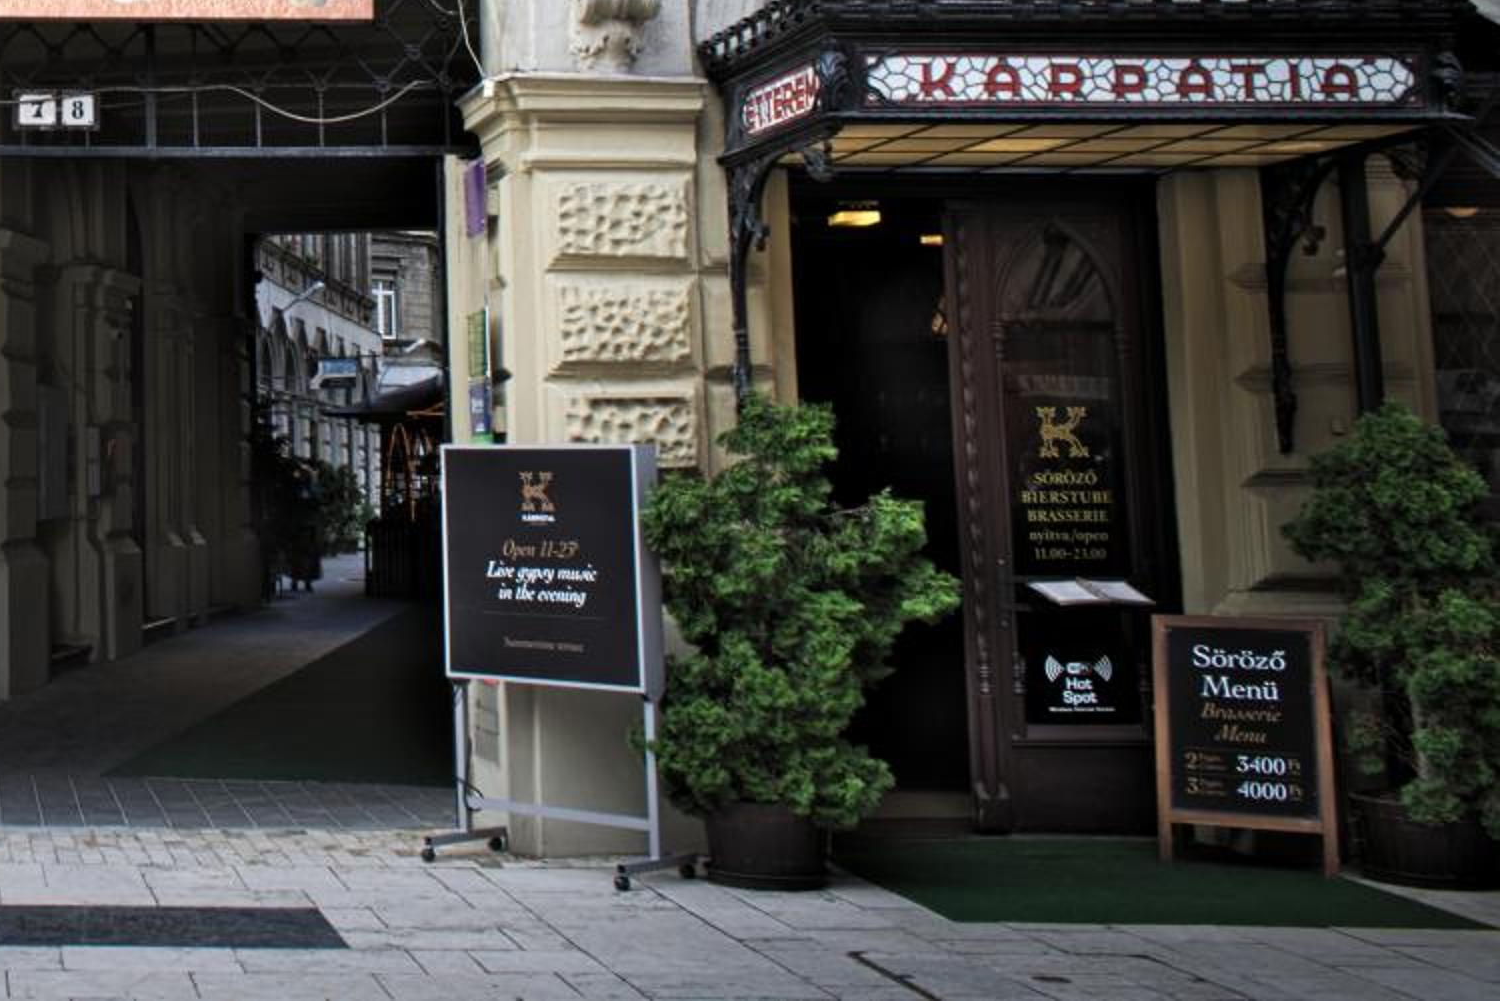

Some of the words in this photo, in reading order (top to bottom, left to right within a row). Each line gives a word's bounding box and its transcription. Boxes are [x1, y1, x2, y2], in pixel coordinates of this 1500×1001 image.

[71, 100, 84, 119] 8
[1028, 510, 1109, 522] BRASSERIE
[502, 538, 536, 561] Open
[486, 560, 515, 578] Live
[516, 567, 555, 585] gypsy
[557, 563, 598, 582] music
[498, 583, 513, 600] in
[515, 582, 536, 601] the
[537, 585, 587, 608] evening
[1192, 643, 1286, 672] Söröző
[1065, 676, 1093, 690] Hot
[1200, 674, 1280, 701] Menü
[1062, 690, 1099, 706] Spot
[1200, 702, 1283, 722] Brasserie
[1214, 724, 1267, 744] Menu
[1235, 754, 1286, 776] 3400
[1236, 780, 1287, 801] 4000
